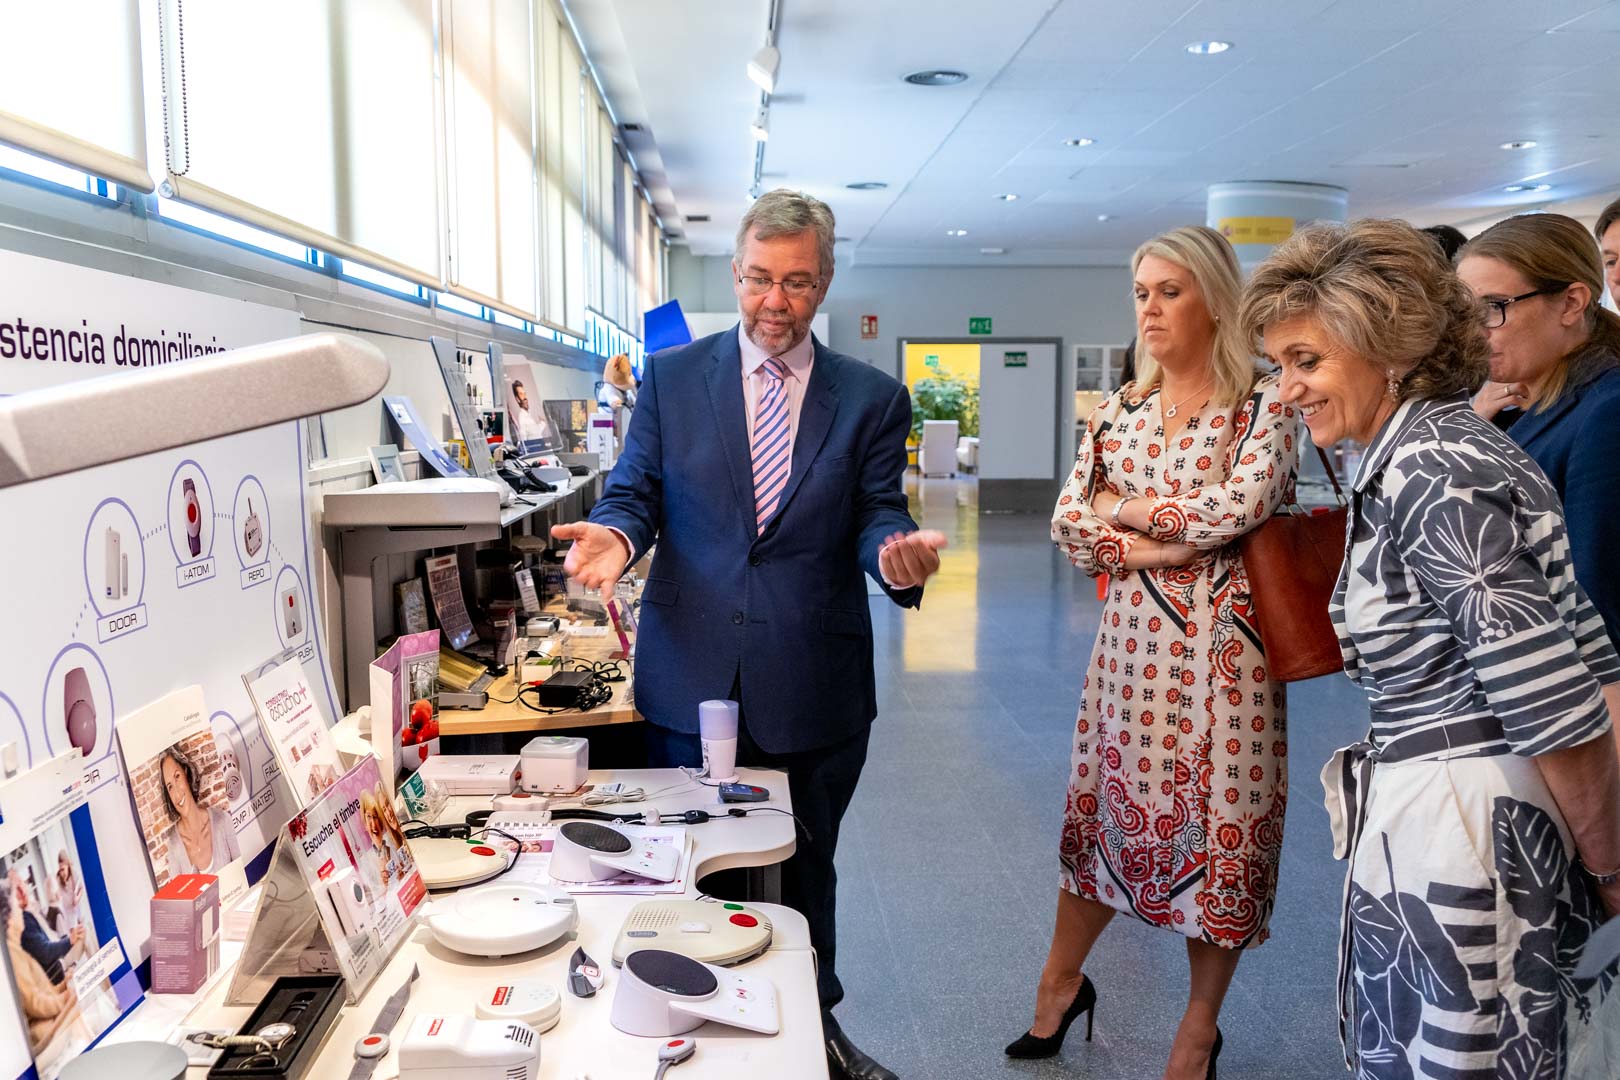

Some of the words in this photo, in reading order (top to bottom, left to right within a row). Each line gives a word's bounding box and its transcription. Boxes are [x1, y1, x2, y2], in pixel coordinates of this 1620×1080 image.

[0, 318, 105, 364] stencia
[113, 324, 225, 367] domicili
[109, 613, 138, 633] DOOR
[251, 789, 272, 812] WATER
[302, 823, 335, 858] Escucha
[333, 813, 342, 830] el
[340, 798, 361, 824] timbre
